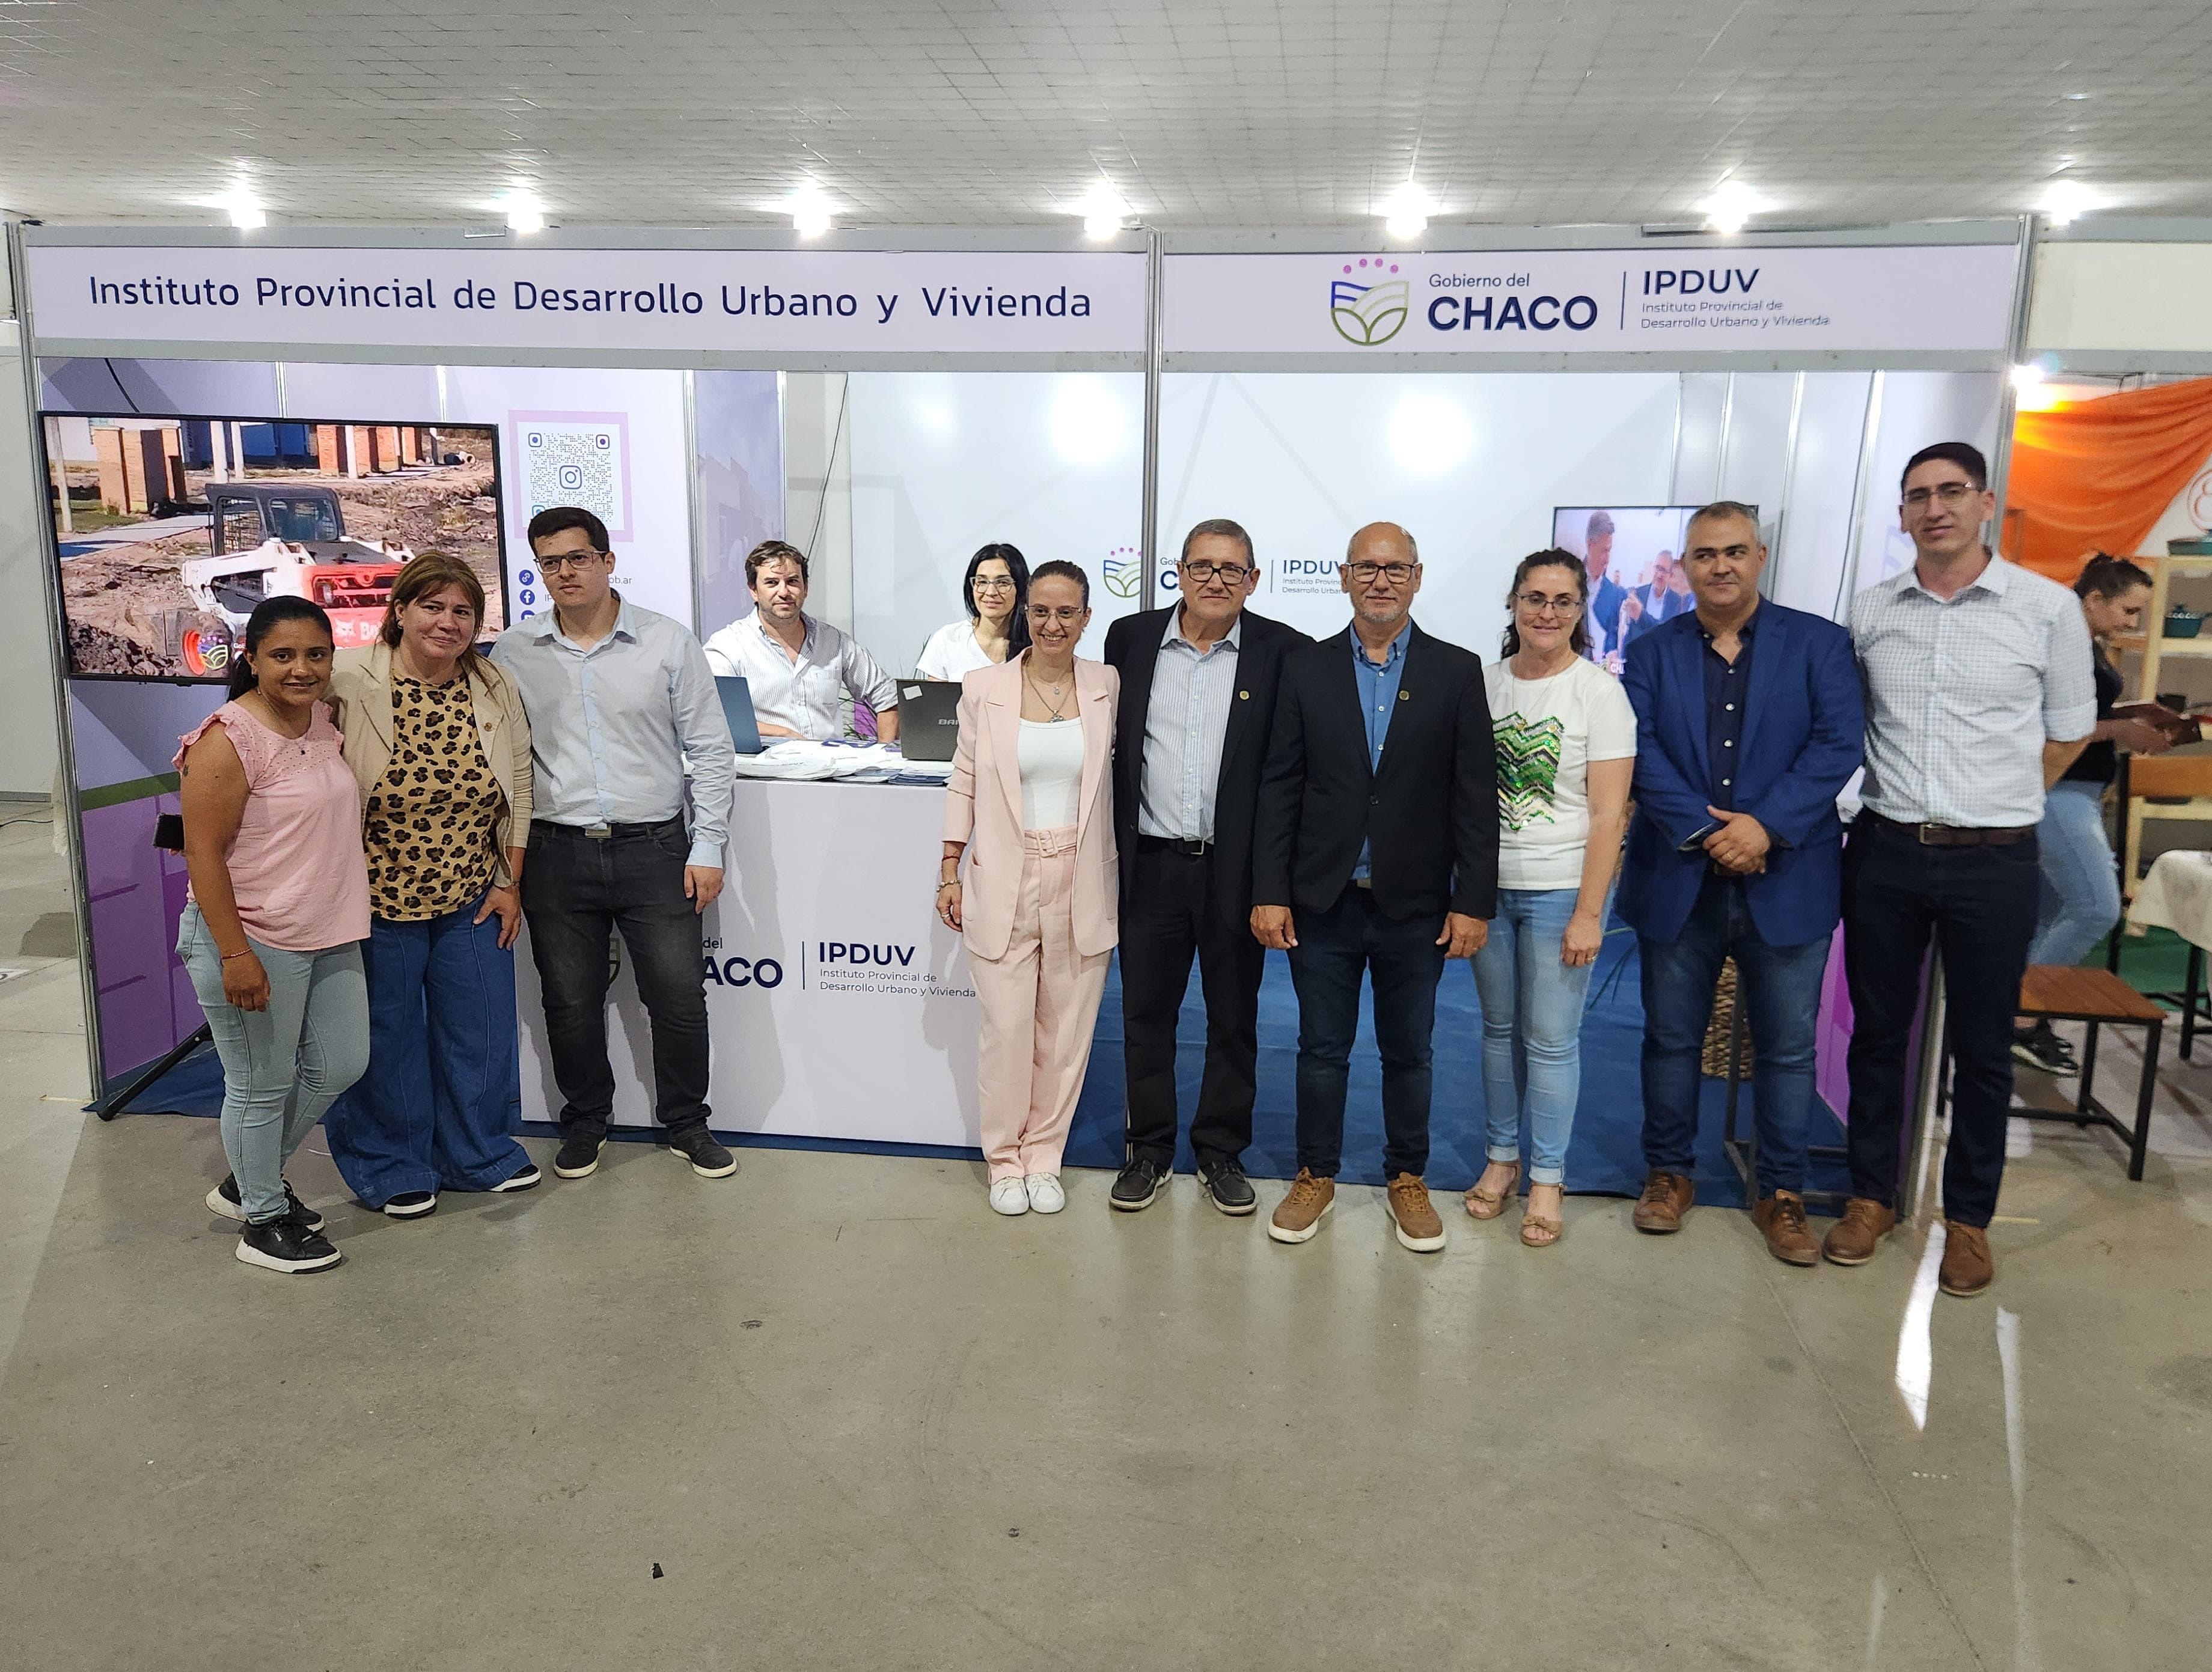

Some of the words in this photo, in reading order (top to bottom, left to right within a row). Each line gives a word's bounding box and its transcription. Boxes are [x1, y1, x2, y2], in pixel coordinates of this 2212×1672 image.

[1429, 273, 1502, 288] Gobierno
[1506, 272, 1530, 287] del
[1643, 268, 1761, 296] IPDUV
[90, 275, 239, 306] Instituto
[256, 277, 437, 309] Provincial
[453, 279, 496, 310] de
[514, 281, 703, 314] Desarrollo
[721, 285, 857, 317] Urbano
[876, 294, 899, 324] y
[921, 285, 1090, 317] Vivienda
[1642, 302, 1696, 313] Instituto
[1700, 301, 1762, 311] Provincial
[1766, 300, 1783, 310] de
[1427, 295, 1598, 331] CHACO
[1641, 317, 1706, 329] Desarrollo
[1710, 316, 1759, 327] Urbano
[1762, 317, 1768, 329] y
[1774, 314, 1830, 326] Vivienda
[703, 936, 723, 949] del
[819, 941, 916, 966] IPDUV
[704, 956, 783, 989] ACO
[820, 969, 865, 979] Instituto
[868, 971, 920, 981] Provincial
[923, 973, 937, 982] de
[820, 981, 875, 992] Desarrollo
[878, 984, 917, 995] Urbano
[920, 987, 927, 997] y
[929, 987, 976, 997] Vivienda
